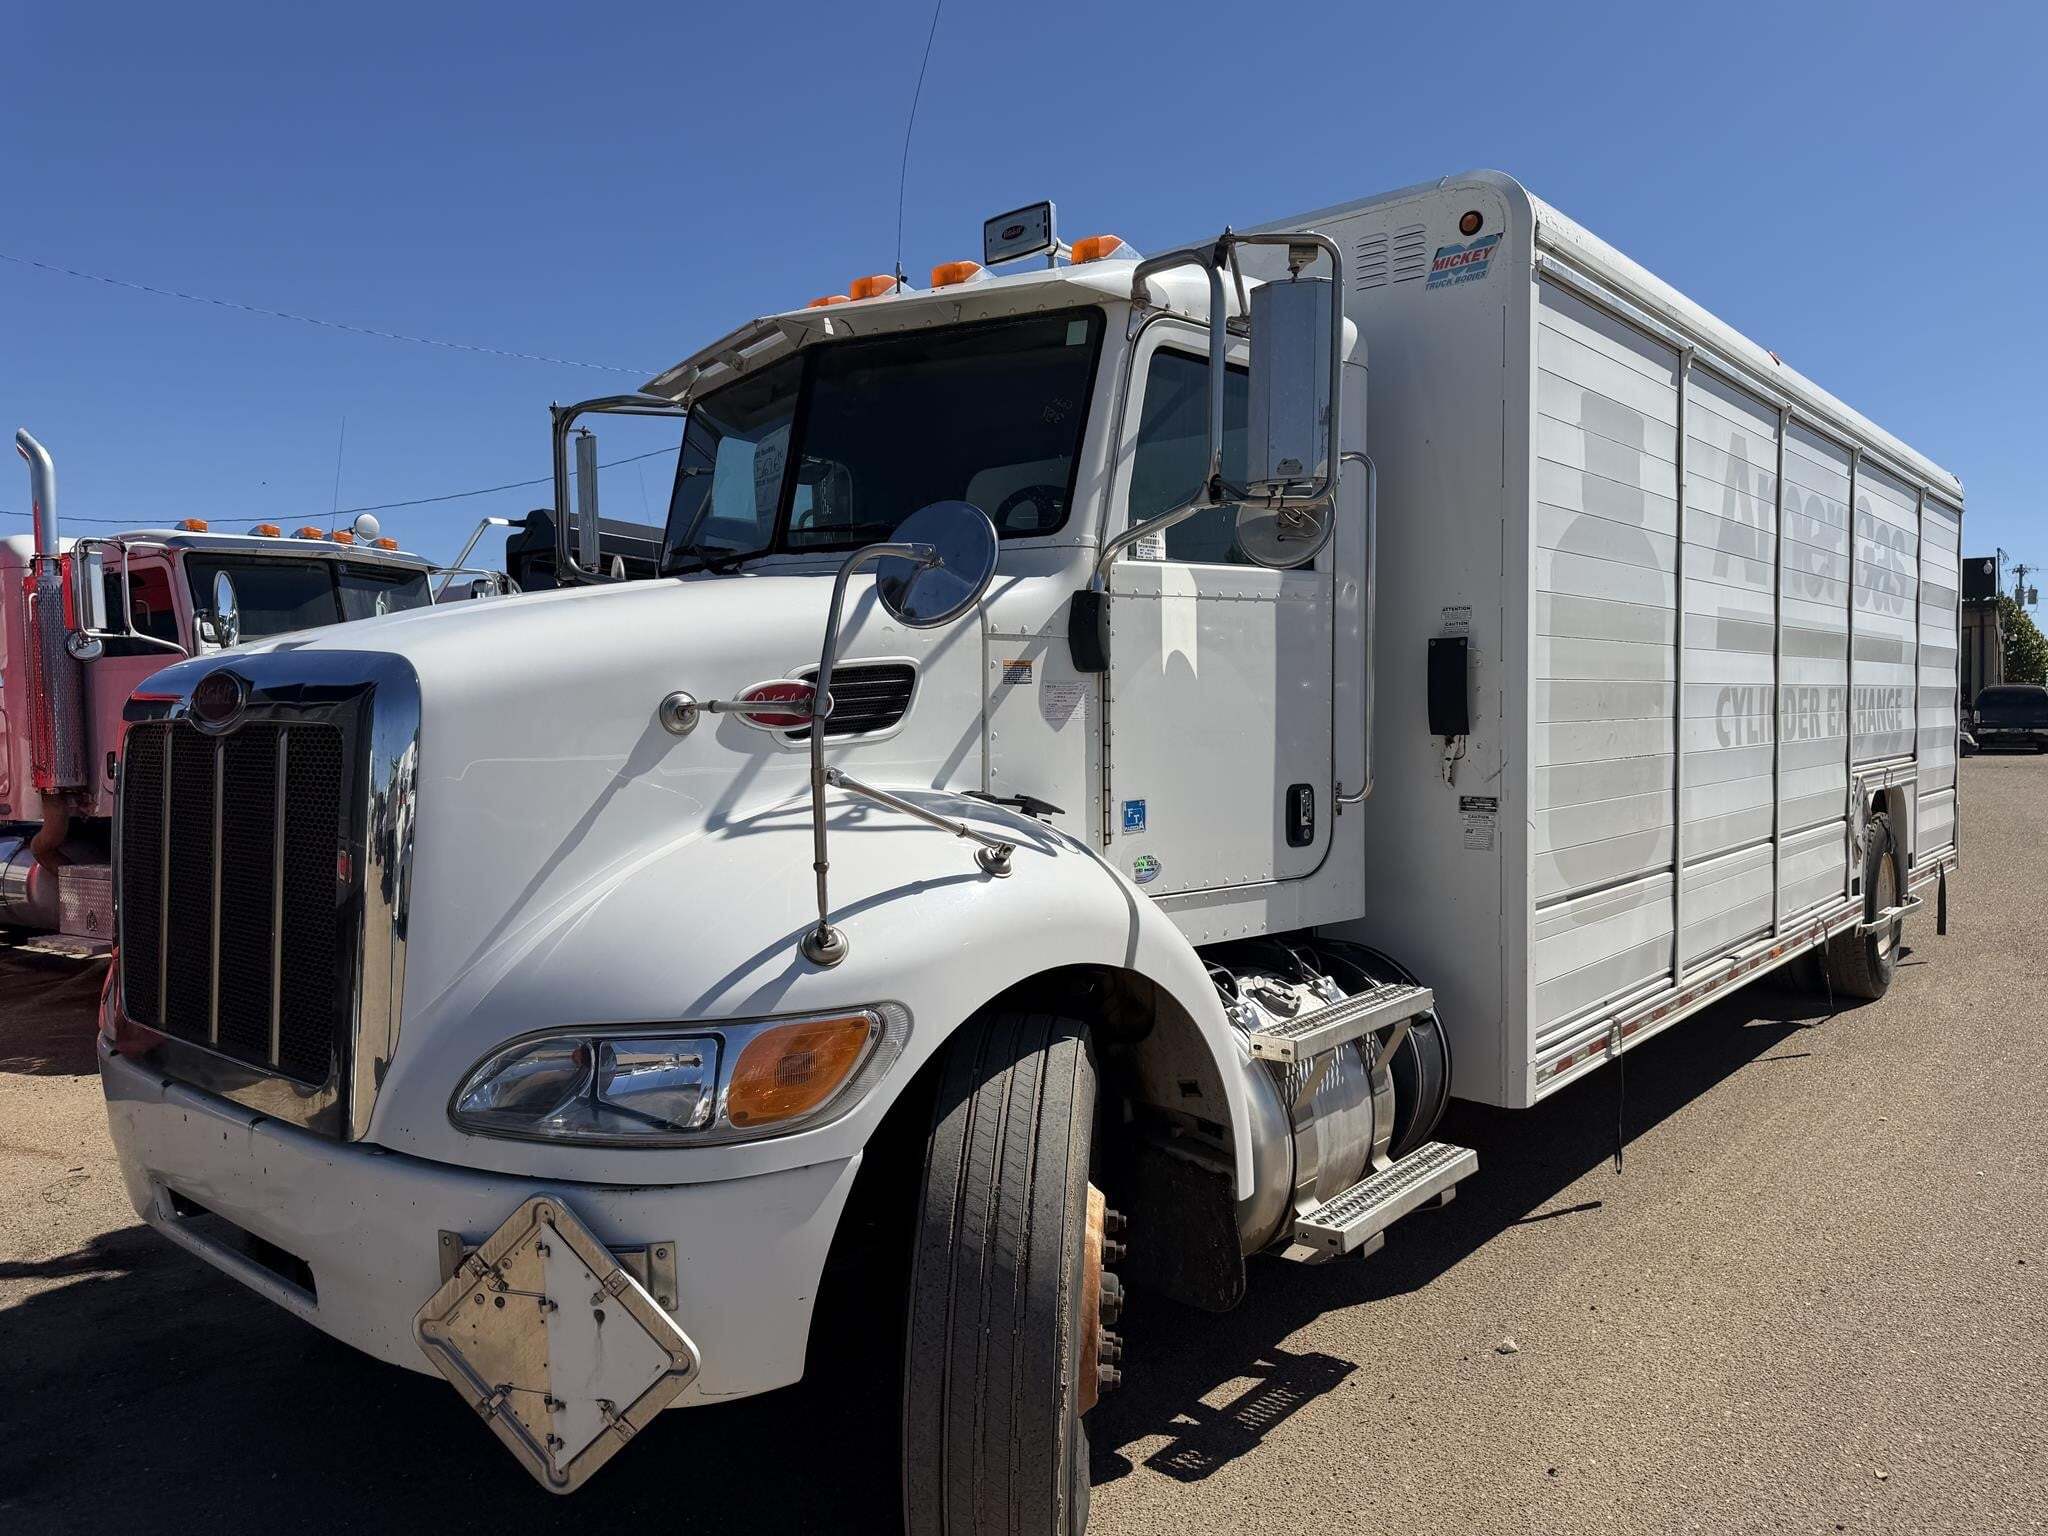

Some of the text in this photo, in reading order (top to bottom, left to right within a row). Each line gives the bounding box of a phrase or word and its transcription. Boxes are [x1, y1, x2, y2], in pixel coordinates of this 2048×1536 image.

[1432, 246, 1495, 272] MICKEY
[1425, 280, 1452, 291] TRUCK
[1712, 432, 1907, 615] AmerGas
[1827, 687, 1903, 737] EXHANGE
